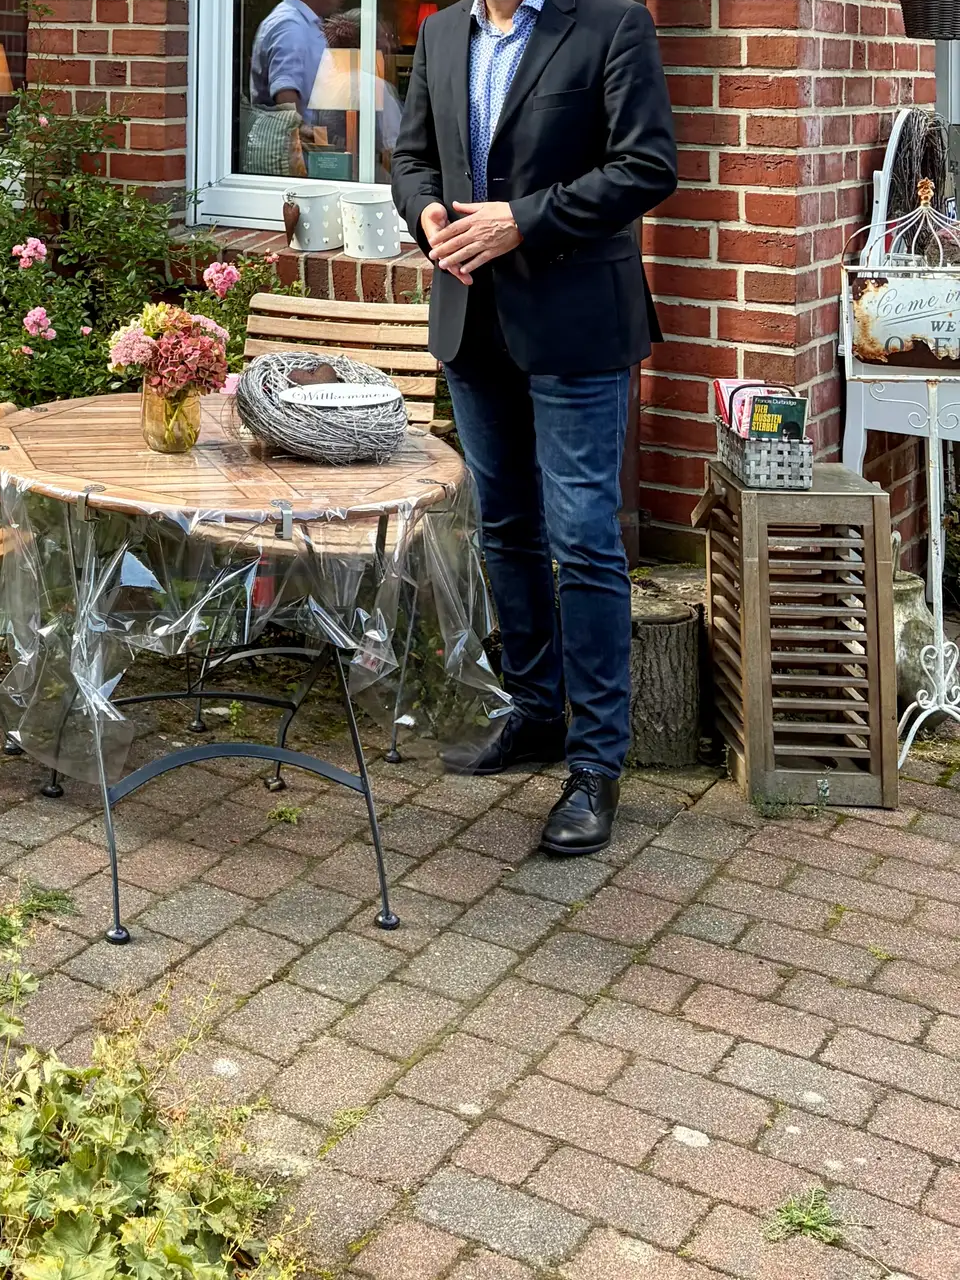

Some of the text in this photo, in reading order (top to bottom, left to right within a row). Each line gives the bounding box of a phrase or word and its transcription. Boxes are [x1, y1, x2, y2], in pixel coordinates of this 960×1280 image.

[876, 288, 939, 318] Come
[930, 320, 960, 332] WE
[755, 404, 768, 413] VIER
[752, 422, 778, 432] STERBEN
